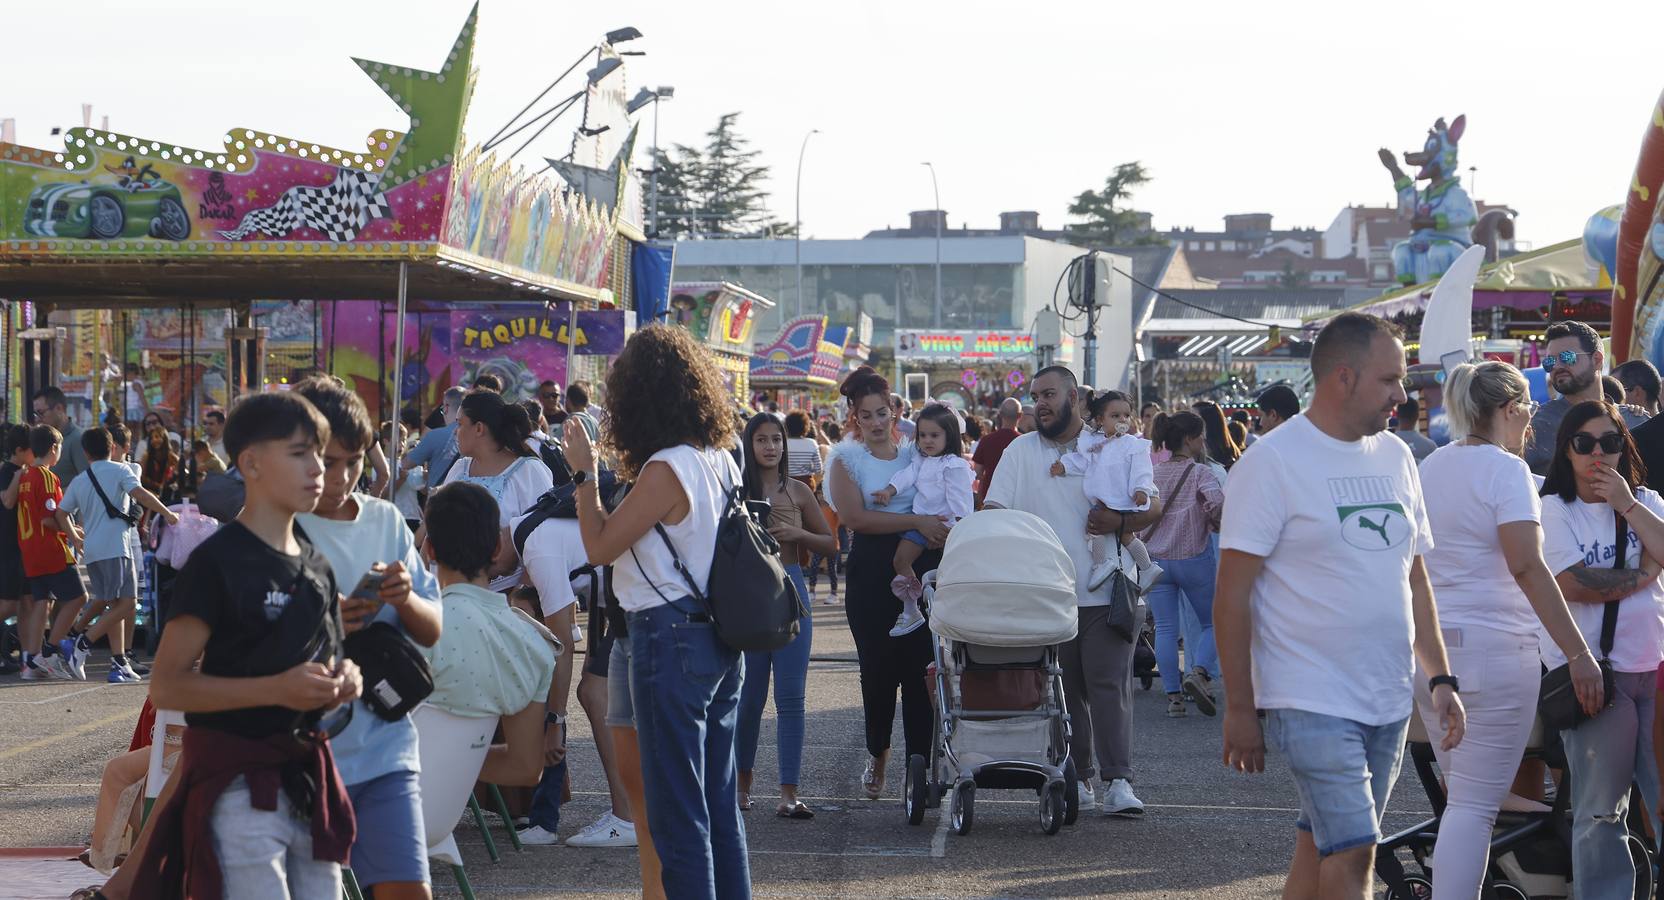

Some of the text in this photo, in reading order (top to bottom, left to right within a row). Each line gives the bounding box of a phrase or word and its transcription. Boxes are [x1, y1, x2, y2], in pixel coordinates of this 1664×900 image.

[463, 317, 588, 349] TAQUILLA
[919, 332, 1034, 352] VINO AÑEJO
[1327, 475, 1395, 505] PUMA
